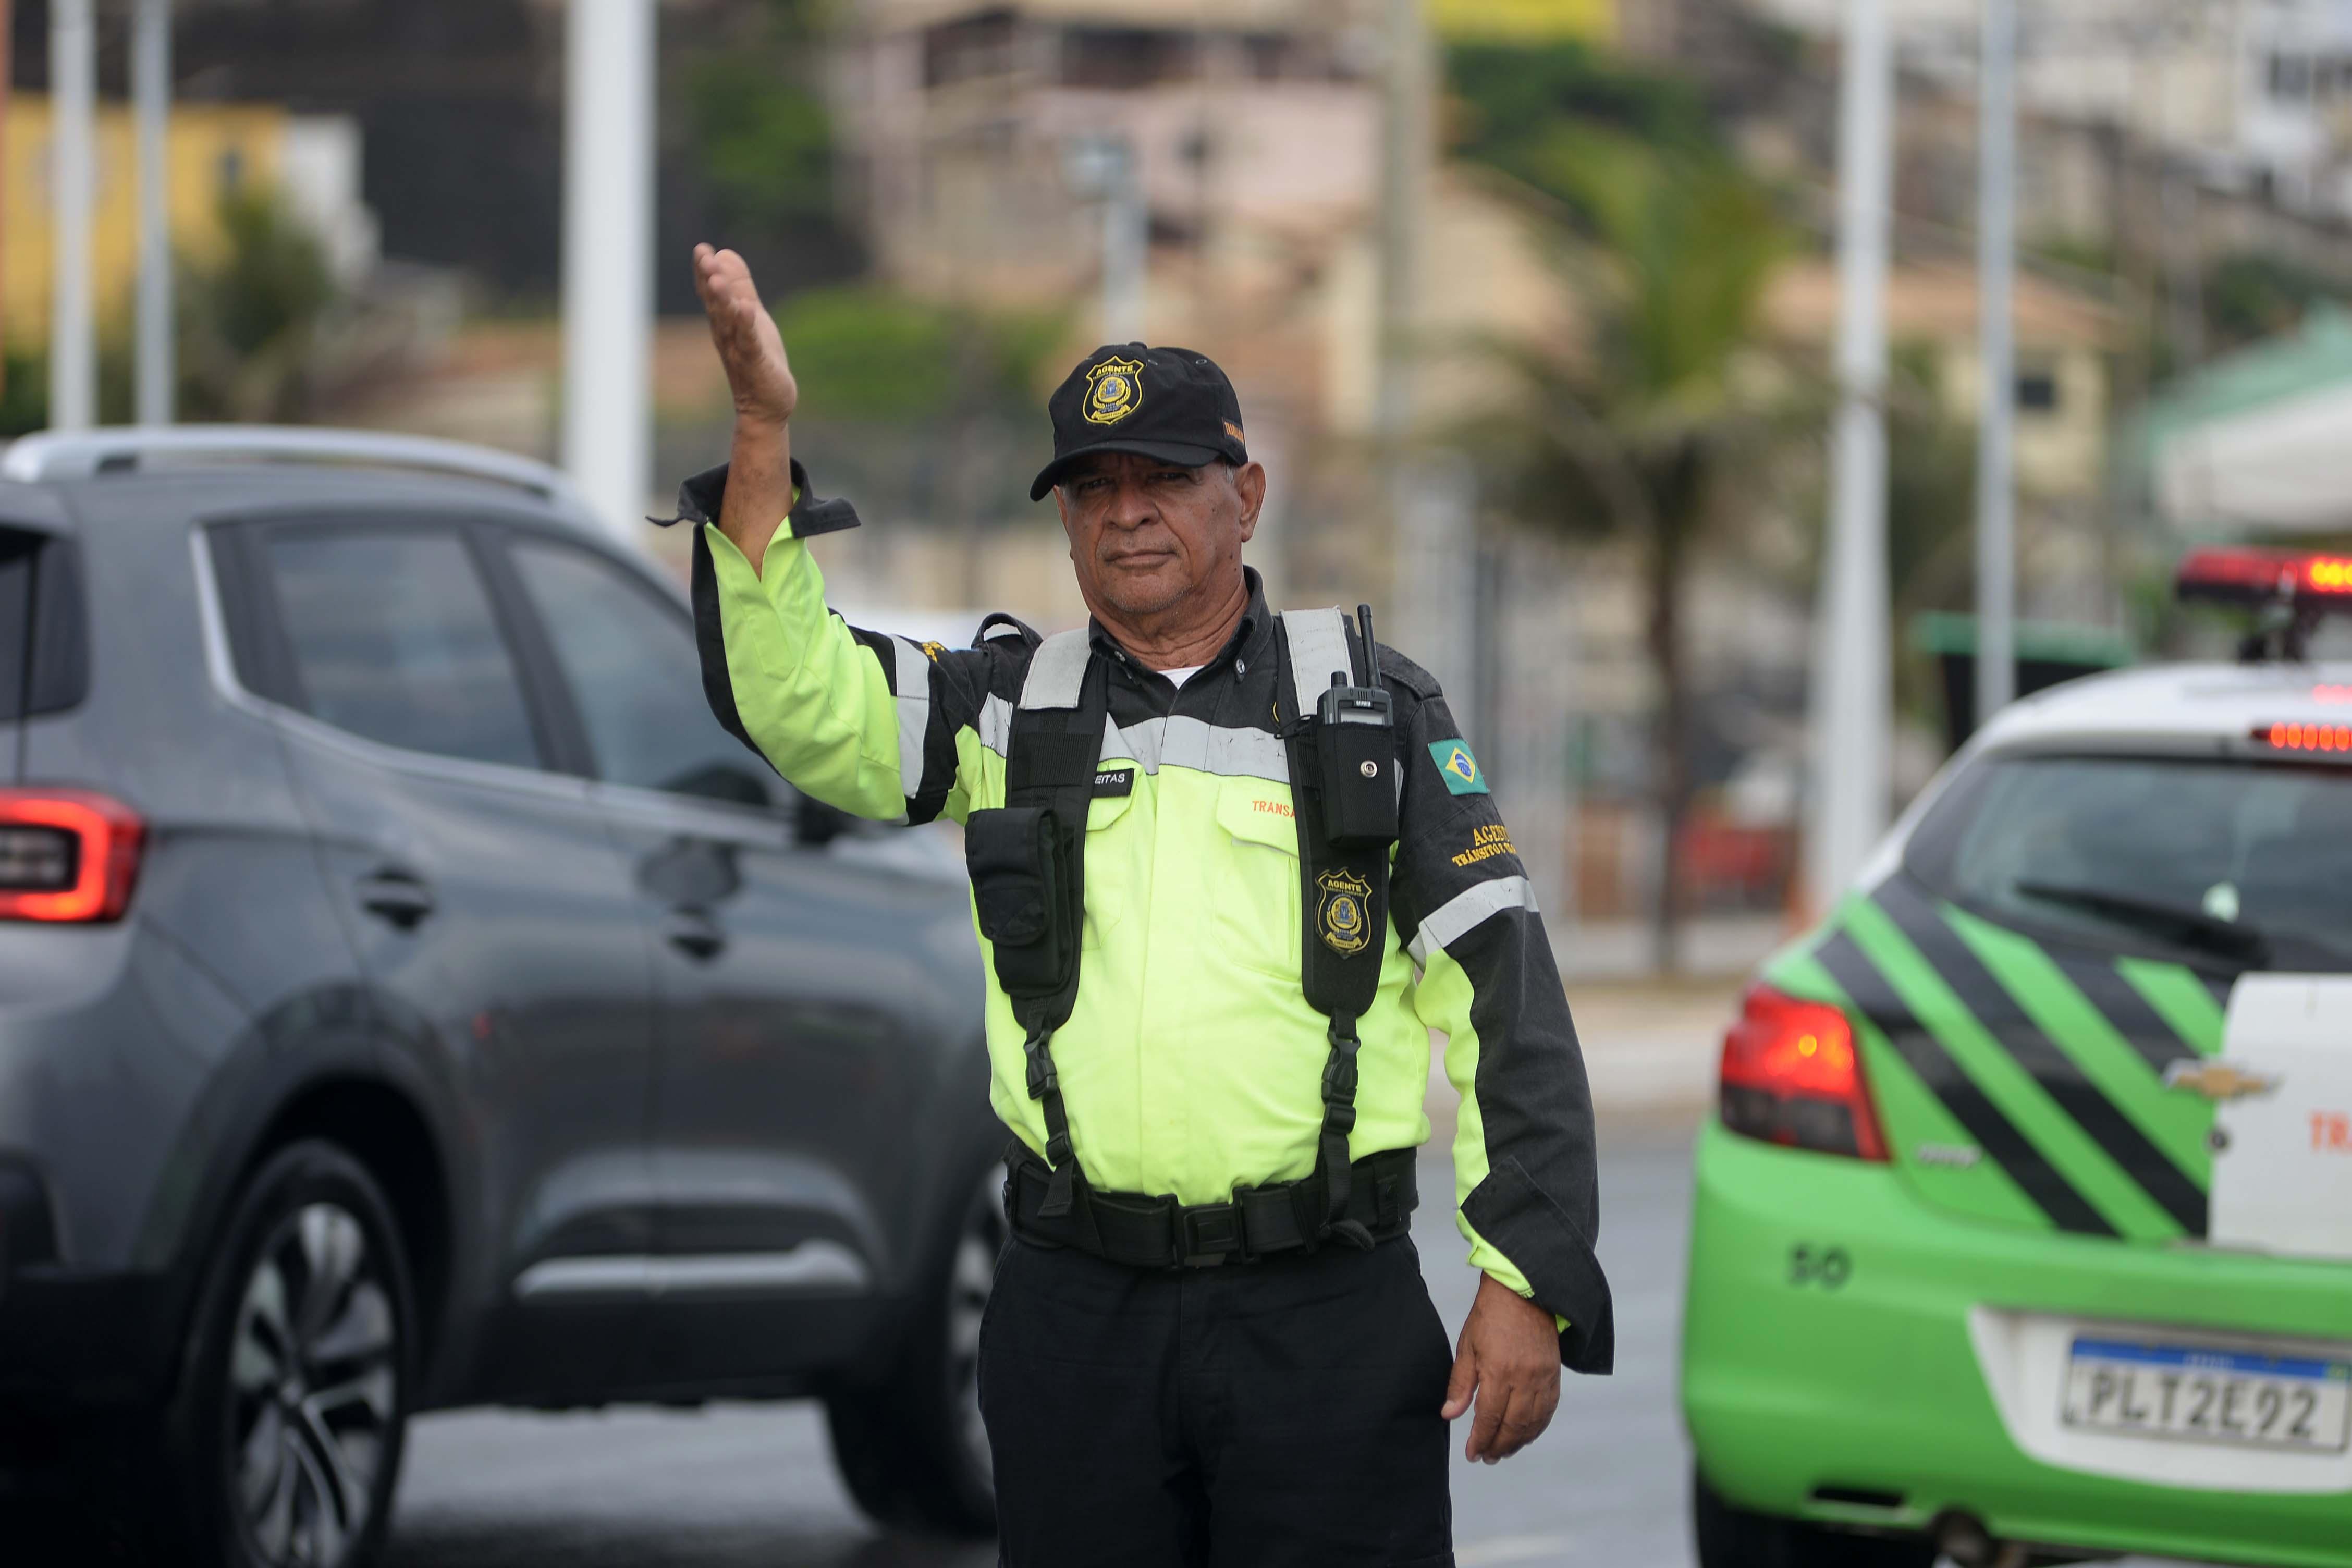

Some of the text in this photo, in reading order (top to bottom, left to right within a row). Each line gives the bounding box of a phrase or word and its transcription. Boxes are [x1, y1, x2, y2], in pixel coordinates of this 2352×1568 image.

[1096, 365, 1133, 376] AGENTE
[1095, 773, 1125, 784] EITAS
[1328, 879, 1361, 892] AGENTE
